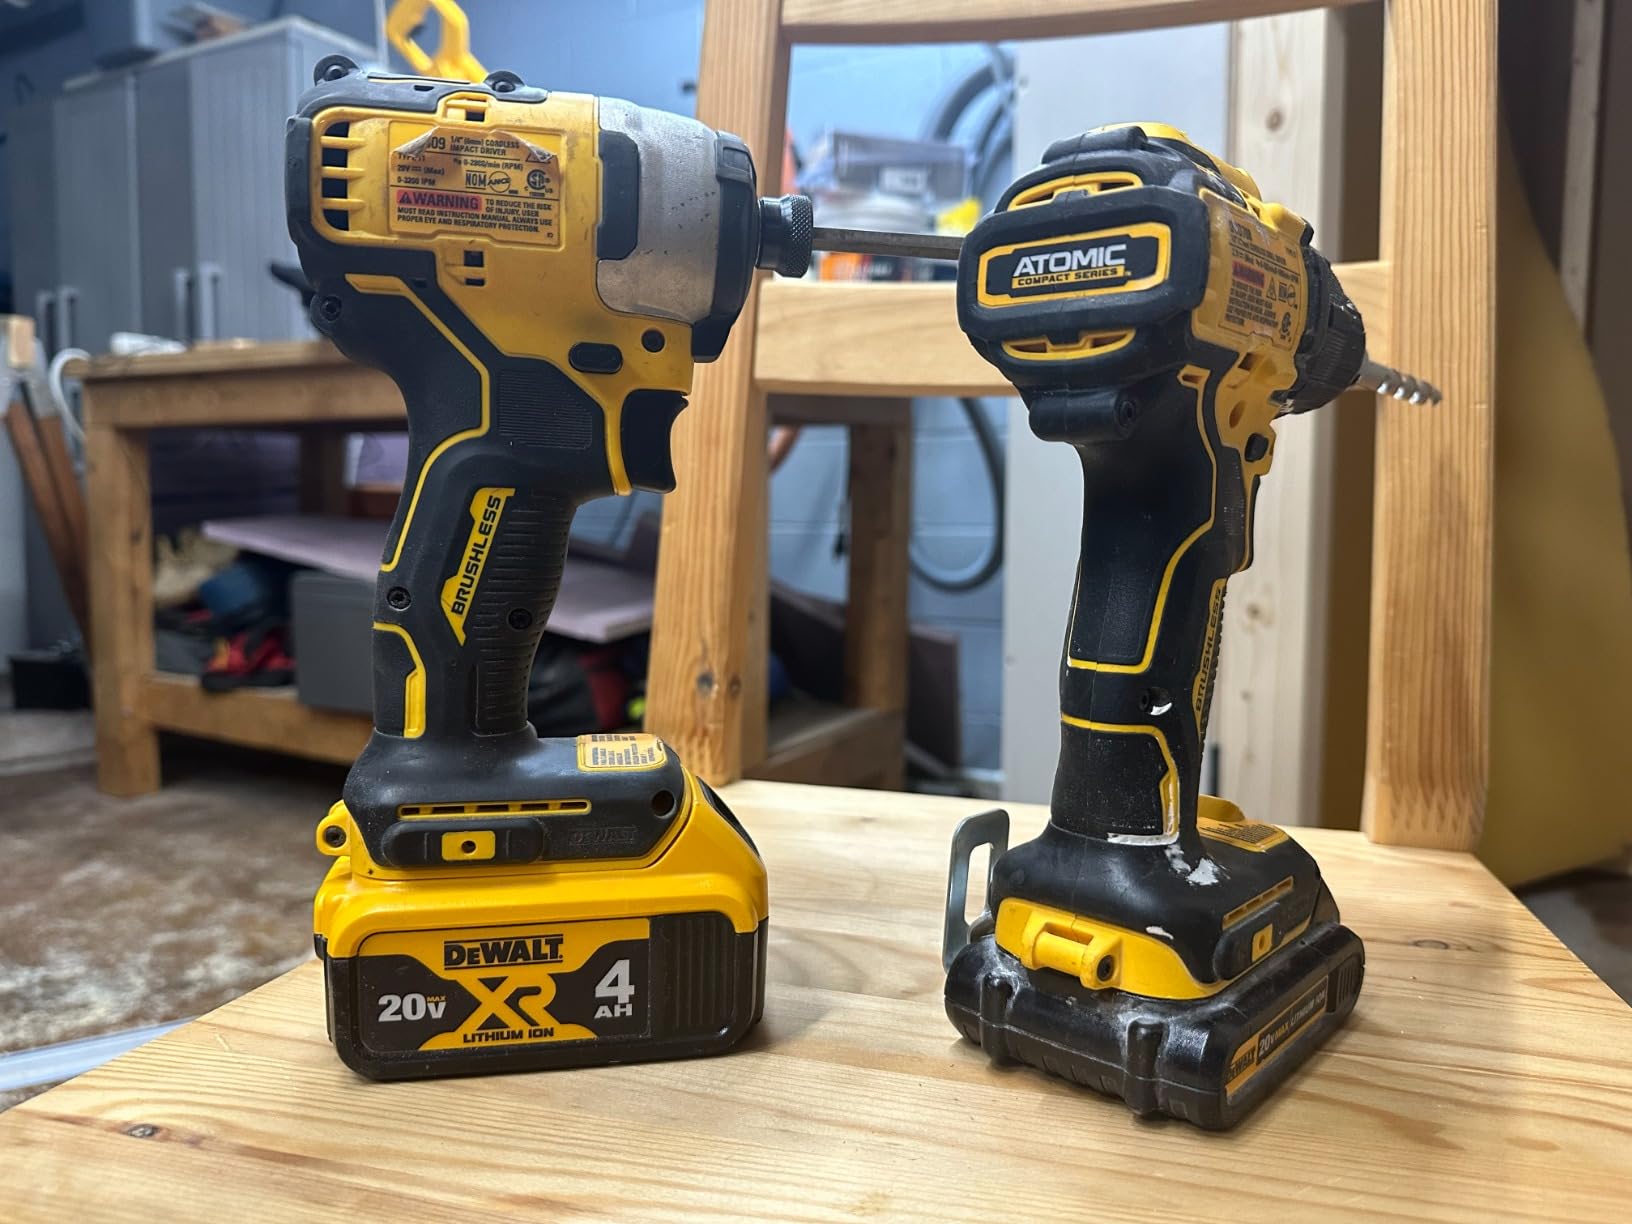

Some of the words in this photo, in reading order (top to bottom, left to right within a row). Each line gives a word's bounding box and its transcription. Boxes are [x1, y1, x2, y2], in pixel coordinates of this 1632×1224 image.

[450, 144, 479, 153] IMPACT
[480, 147, 506, 156] DRIVER
[485, 139, 520, 149] CORDLESS
[424, 166, 445, 176] (Max)
[502, 162, 524, 171] (RPM)
[421, 178, 436, 186] IPM
[466, 173, 486, 186] NOM
[412, 192, 479, 209] WARNING
[496, 200, 521, 208] REDUCE
[418, 208, 435, 216] READ
[436, 210, 479, 220] INSTRUCTION
[512, 216, 539, 224] ALWAYS
[425, 216, 437, 224] EYE
[454, 219, 497, 228] RESPIRATORY
[1013, 244, 1127, 277] ATOMIC
[1018, 274, 1070, 286] COMPACT
[1074, 268, 1118, 280] SERIES
[451, 495, 501, 615] BRUSHLESS
[1196, 586, 1221, 712] BRUSHLESS
[444, 937, 564, 966] DEWALT
[594, 959, 635, 1004] 4
[378, 992, 447, 1022] 20V
[455, 973, 560, 1030] XR
[594, 1004, 632, 1019] AH
[1290, 999, 1315, 1026] LITHIUM
[463, 1030, 523, 1044] LITHIUM
[528, 1027, 554, 1038] ION
